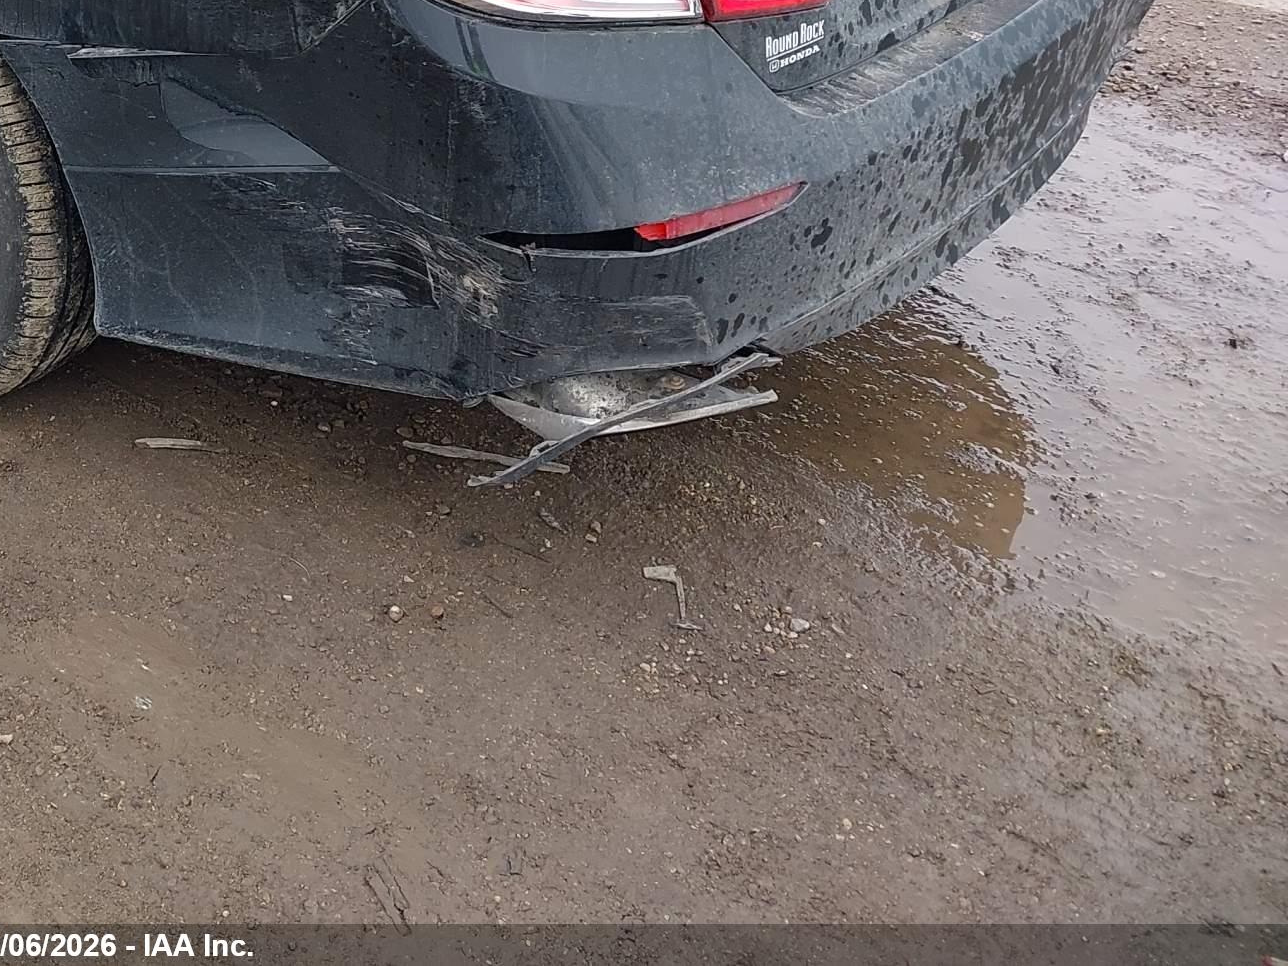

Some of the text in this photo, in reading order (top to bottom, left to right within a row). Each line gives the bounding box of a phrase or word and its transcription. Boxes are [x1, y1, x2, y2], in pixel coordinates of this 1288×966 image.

[765, 20, 825, 59] ROUND ROCK
[780, 45, 821, 68] HONDA
